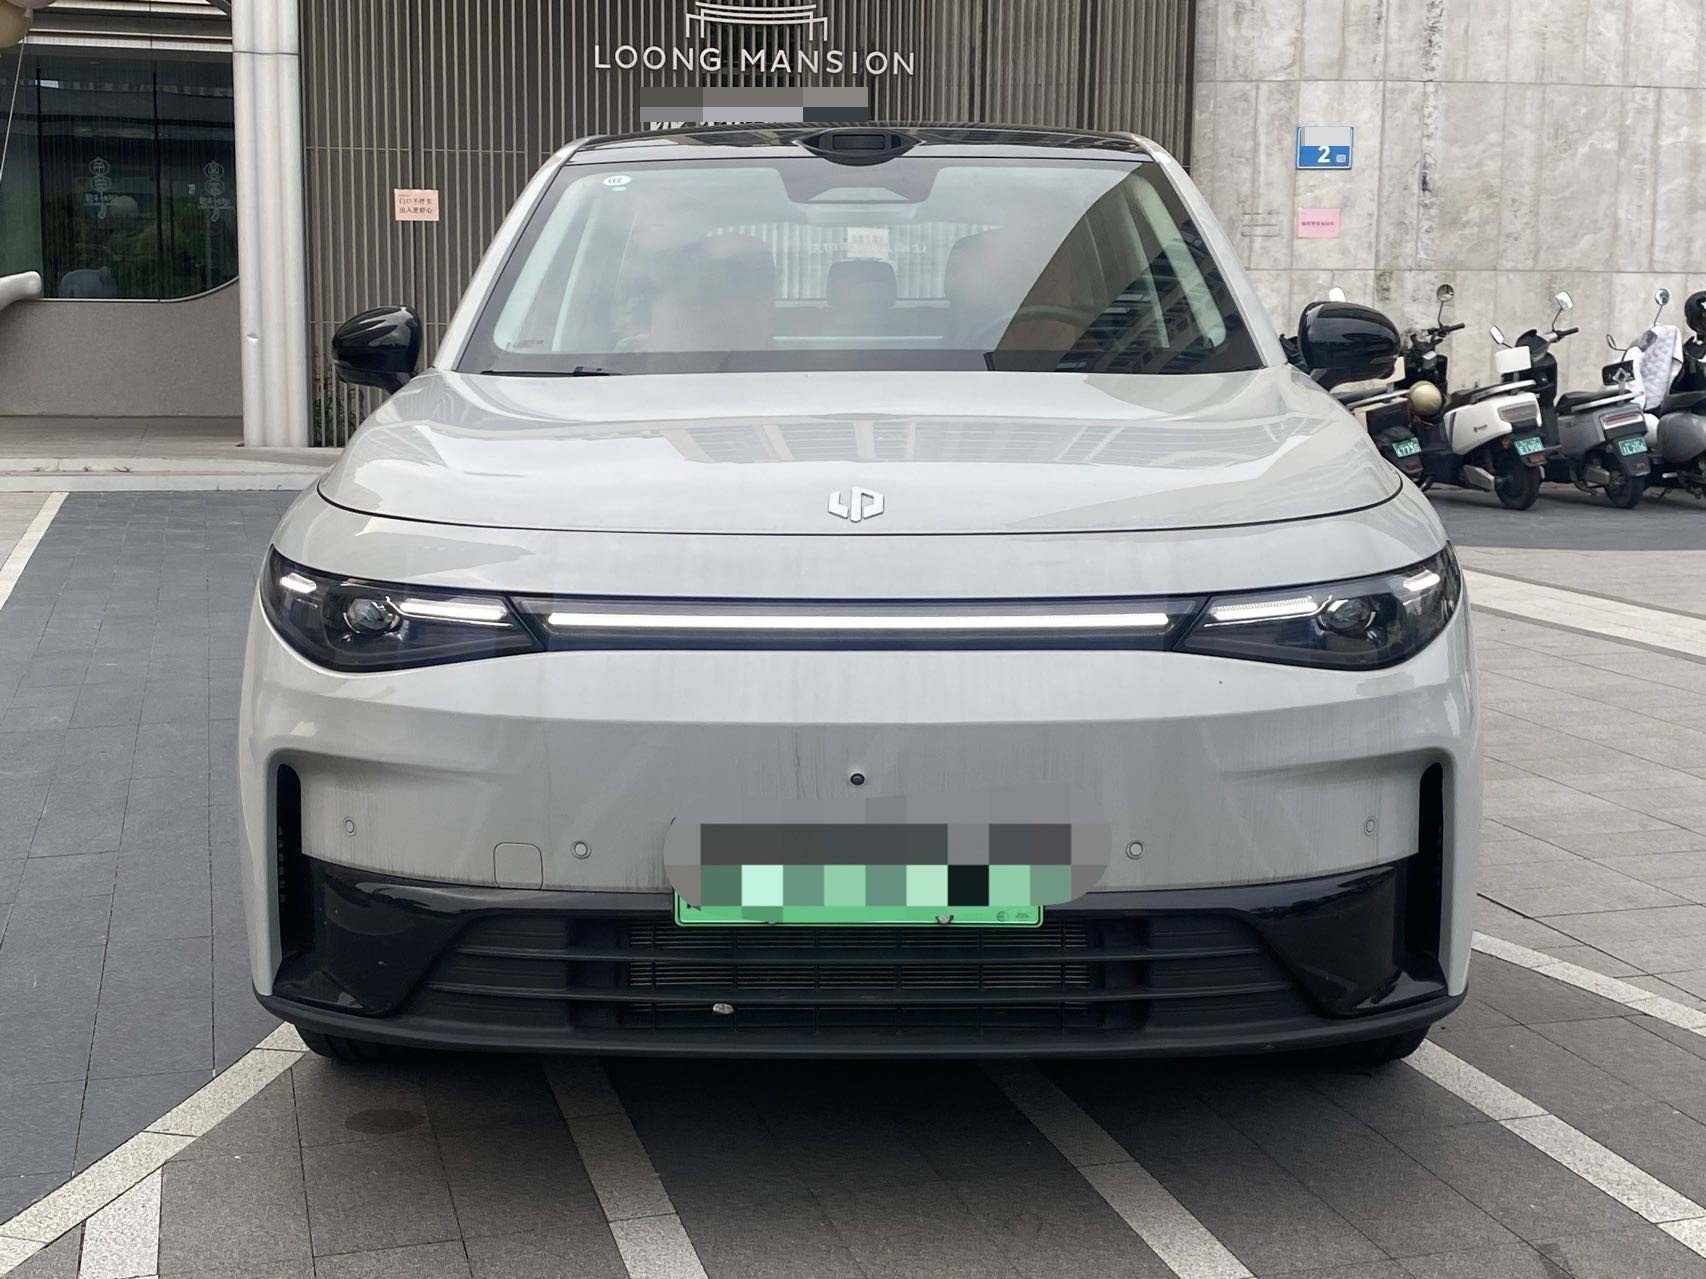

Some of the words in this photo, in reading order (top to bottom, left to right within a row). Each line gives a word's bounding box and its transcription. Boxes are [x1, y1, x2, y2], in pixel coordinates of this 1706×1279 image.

[594, 45, 721, 71] LOONG
[741, 48, 915, 75] MANSION
[1317, 146, 1331, 163] 2
